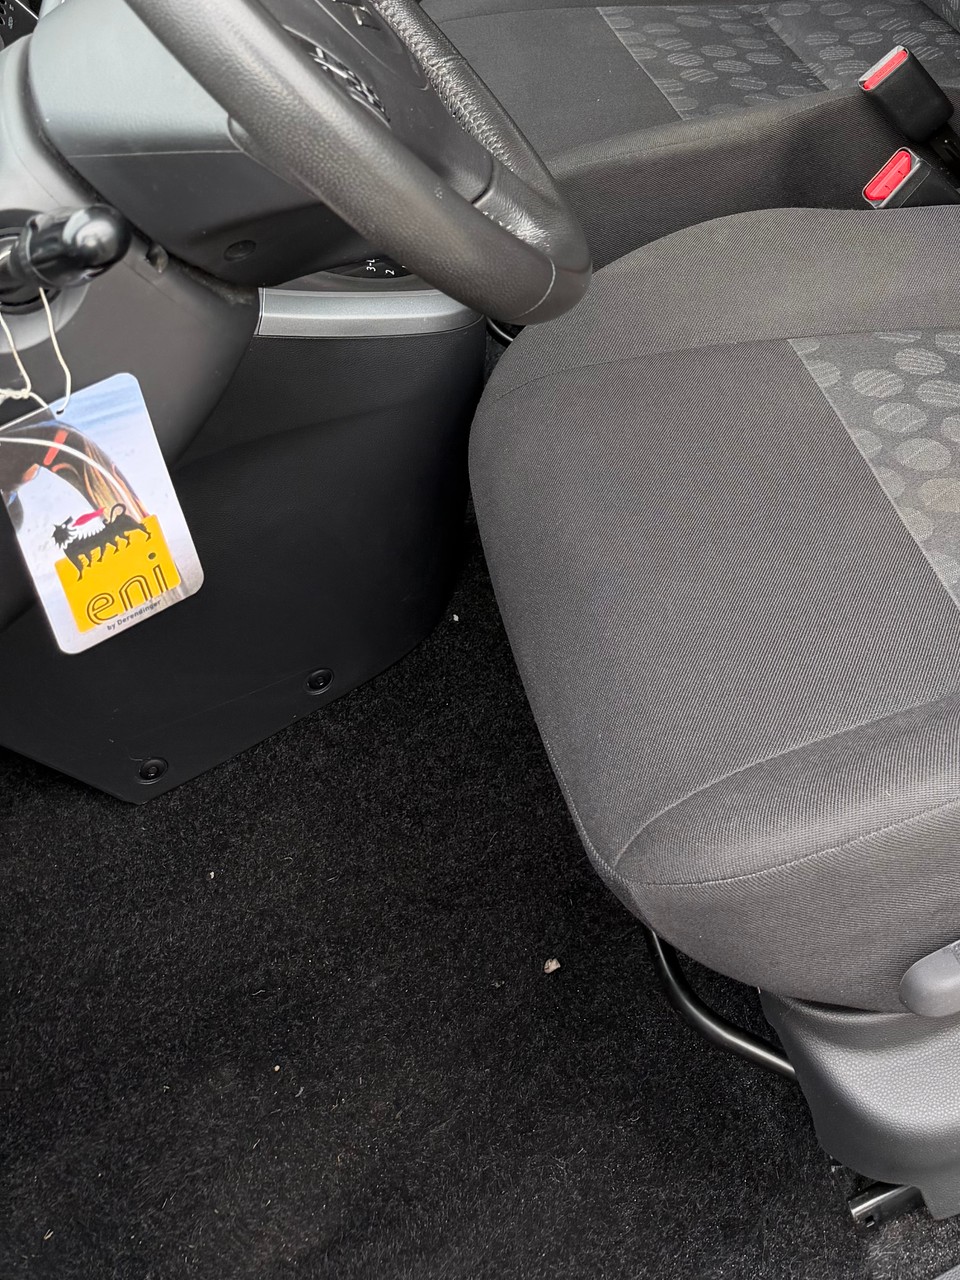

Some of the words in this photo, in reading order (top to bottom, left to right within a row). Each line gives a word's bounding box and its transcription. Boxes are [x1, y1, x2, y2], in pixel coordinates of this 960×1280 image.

[86, 552, 169, 626] eni
[106, 623, 116, 631] by
[117, 600, 162, 626] Derendinger
